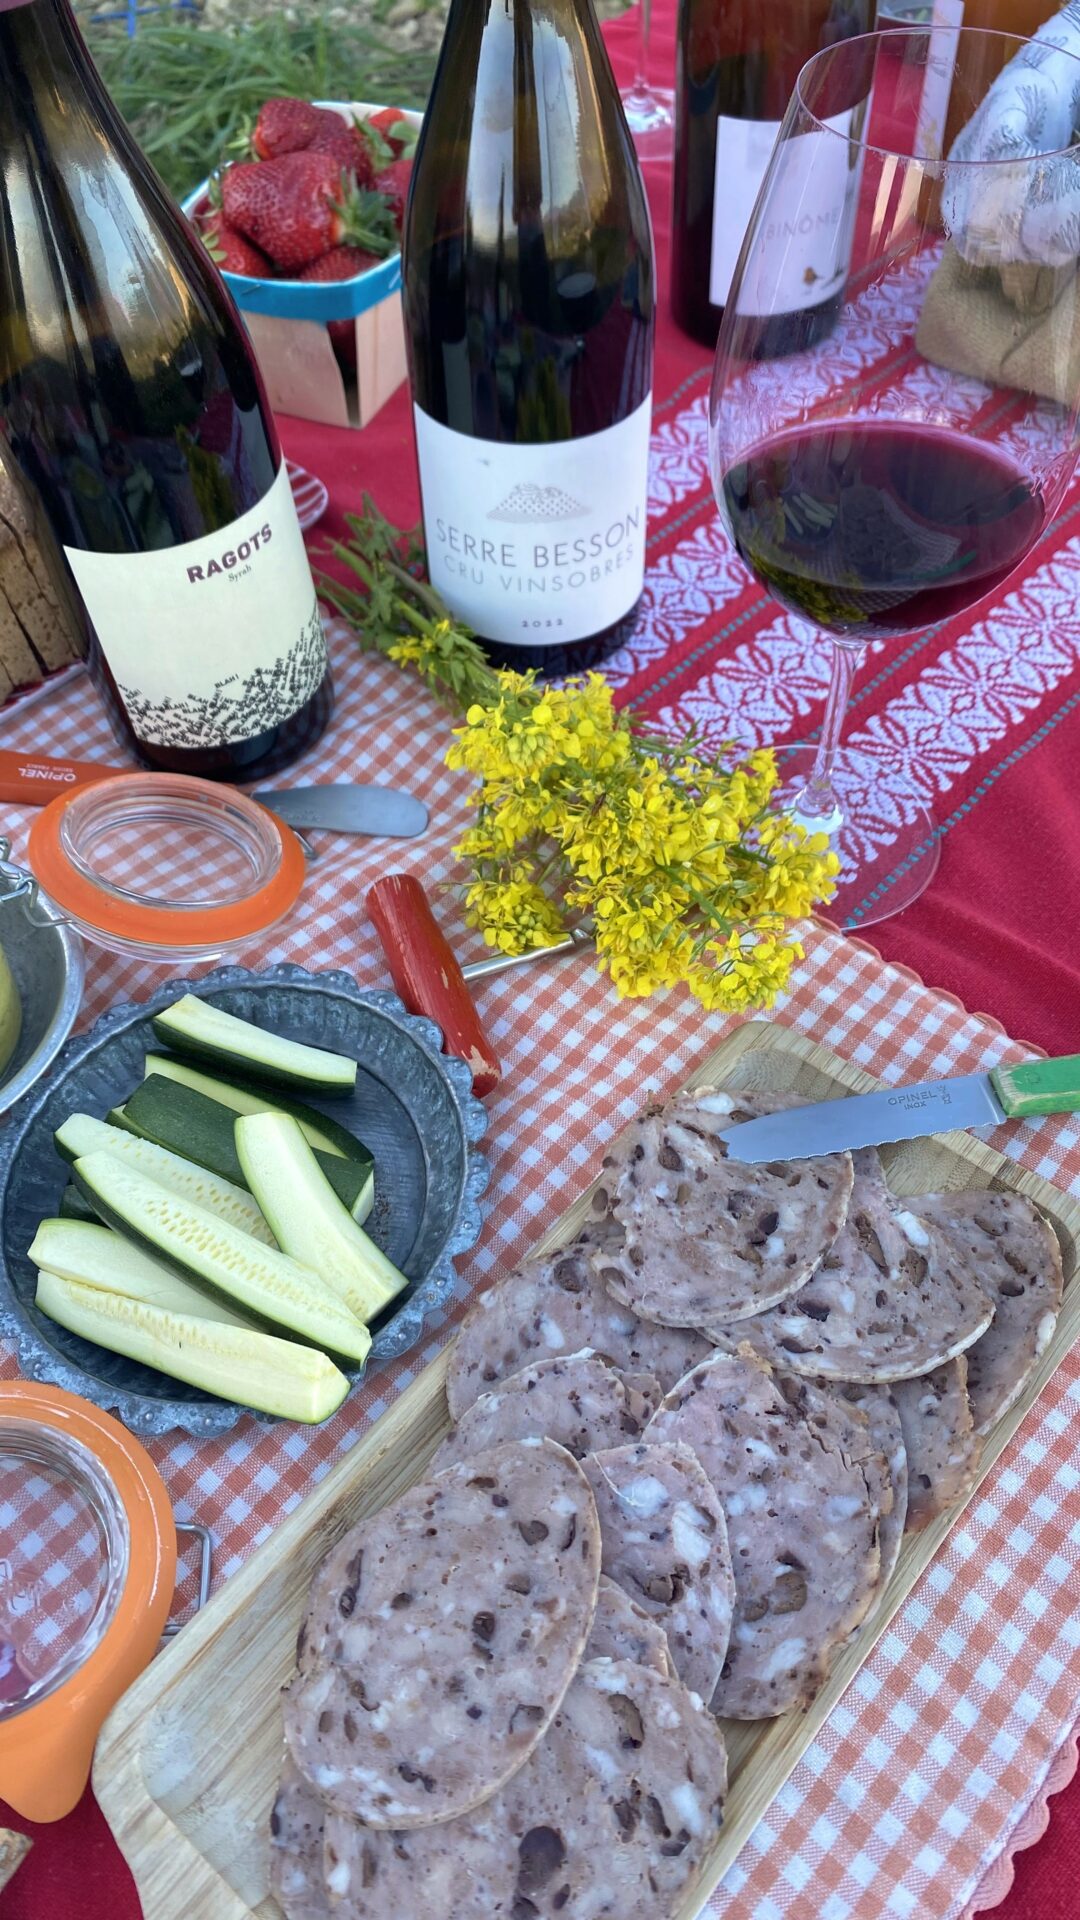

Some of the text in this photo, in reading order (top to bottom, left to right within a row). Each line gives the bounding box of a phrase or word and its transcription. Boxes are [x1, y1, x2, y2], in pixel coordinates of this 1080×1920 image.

[435, 504, 640, 568] SERRE BESSON
[185, 522, 273, 584] RAGOTS
[228, 564, 252, 584] Syrah
[443, 543, 634, 593] CRU VINSOBRES
[520, 618, 564, 629] 2022
[214, 674, 240, 690] BLAH!
[18, 767, 76, 783] OPINEL
[887, 1090, 938, 1106] OPINEL
[904, 1101, 928, 1110] INOX
